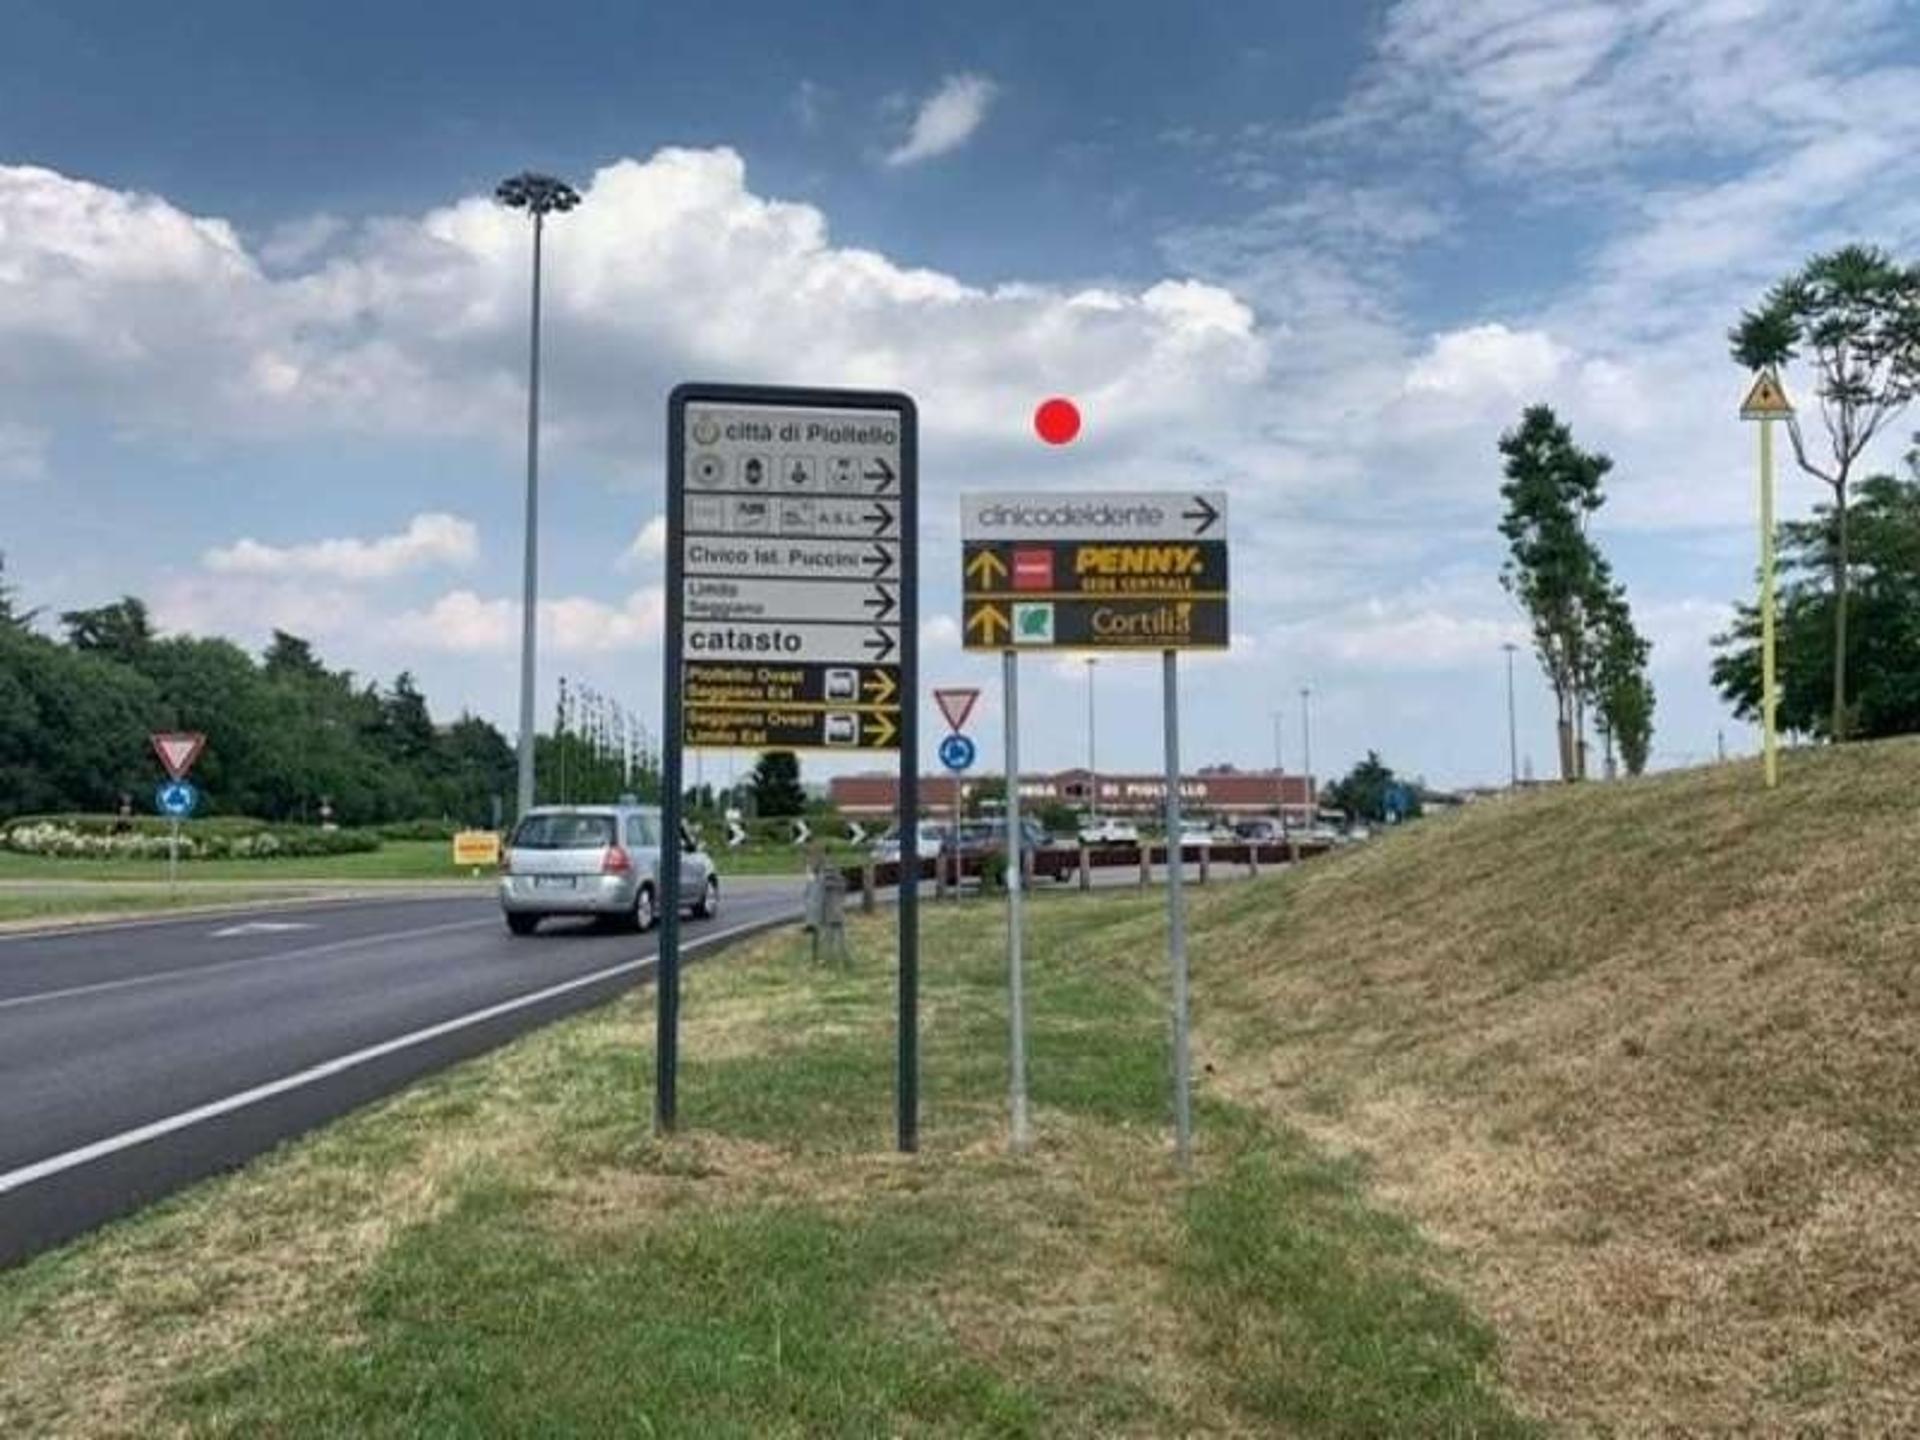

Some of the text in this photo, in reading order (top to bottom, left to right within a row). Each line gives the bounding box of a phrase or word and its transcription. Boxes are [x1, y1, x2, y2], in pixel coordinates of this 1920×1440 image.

[779, 423, 799, 442] di
[806, 423, 897, 445] Pioltello
[688, 546, 748, 564] Civico
[689, 628, 802, 652] catasto
